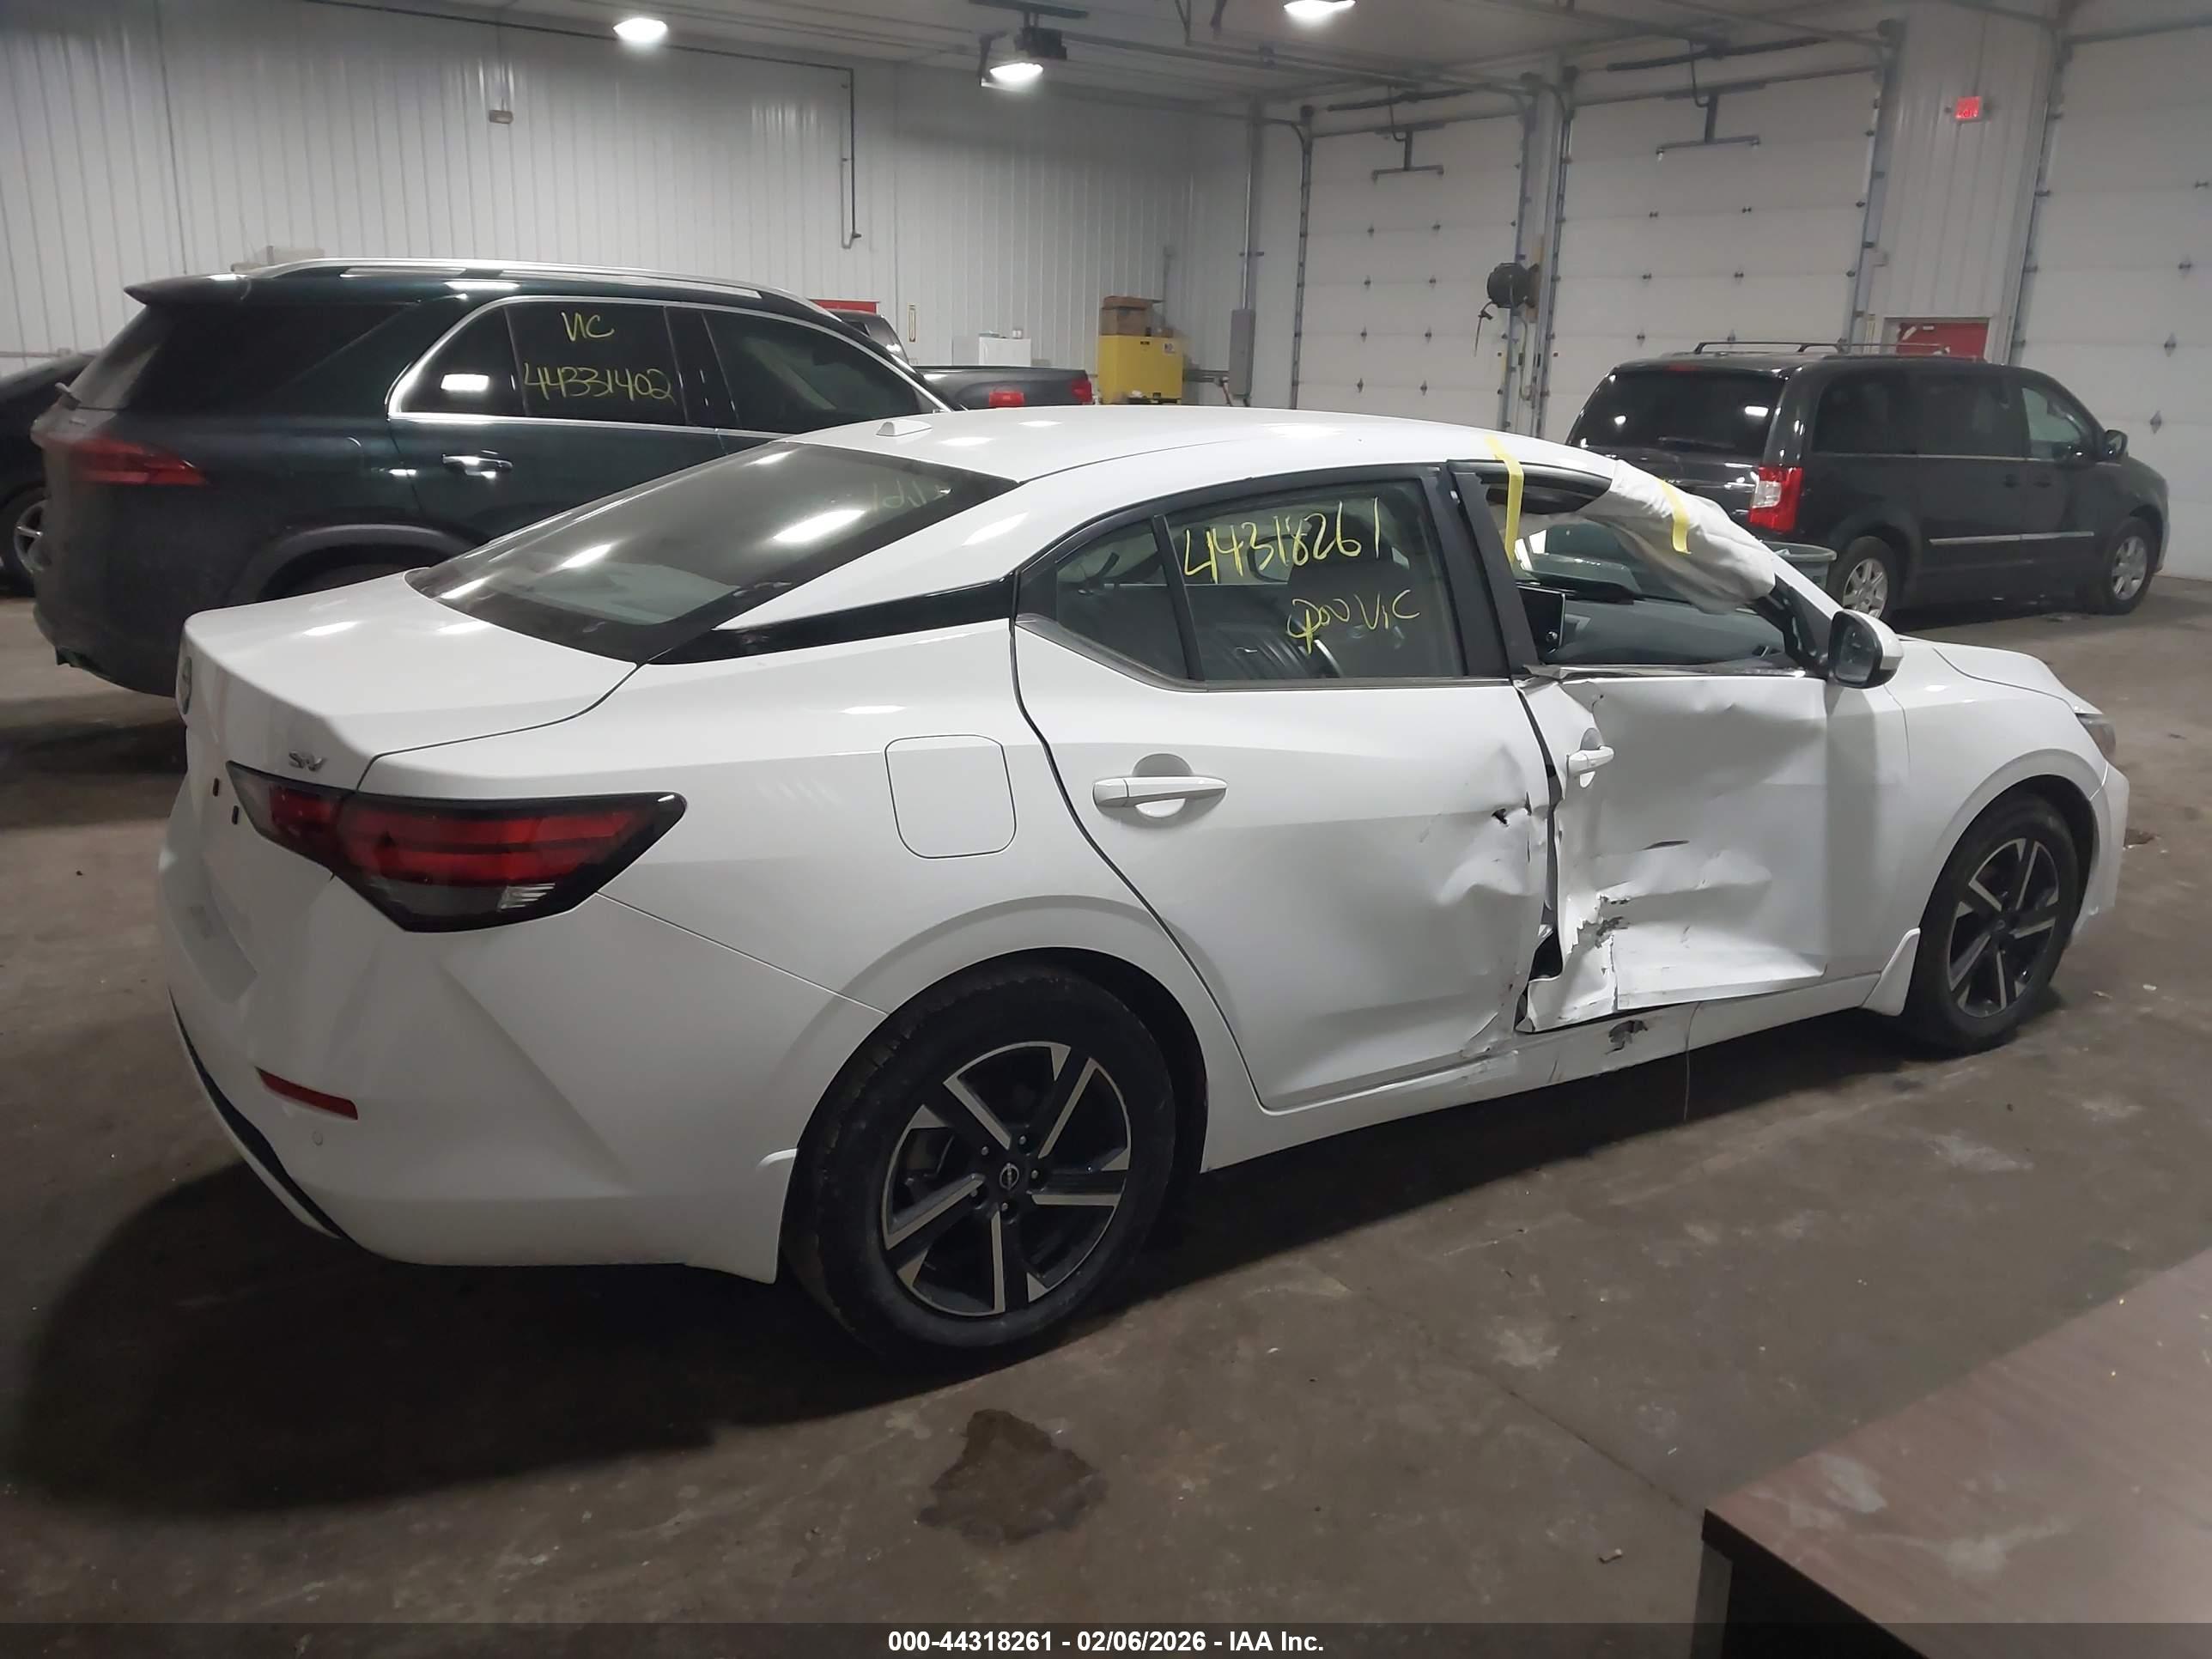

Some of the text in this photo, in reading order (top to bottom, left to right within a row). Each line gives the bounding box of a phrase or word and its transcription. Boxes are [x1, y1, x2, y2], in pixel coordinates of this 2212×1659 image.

[523, 362, 678, 406] 44331402
[1183, 495, 1381, 585] 44318261
[288, 750, 327, 772] SV
